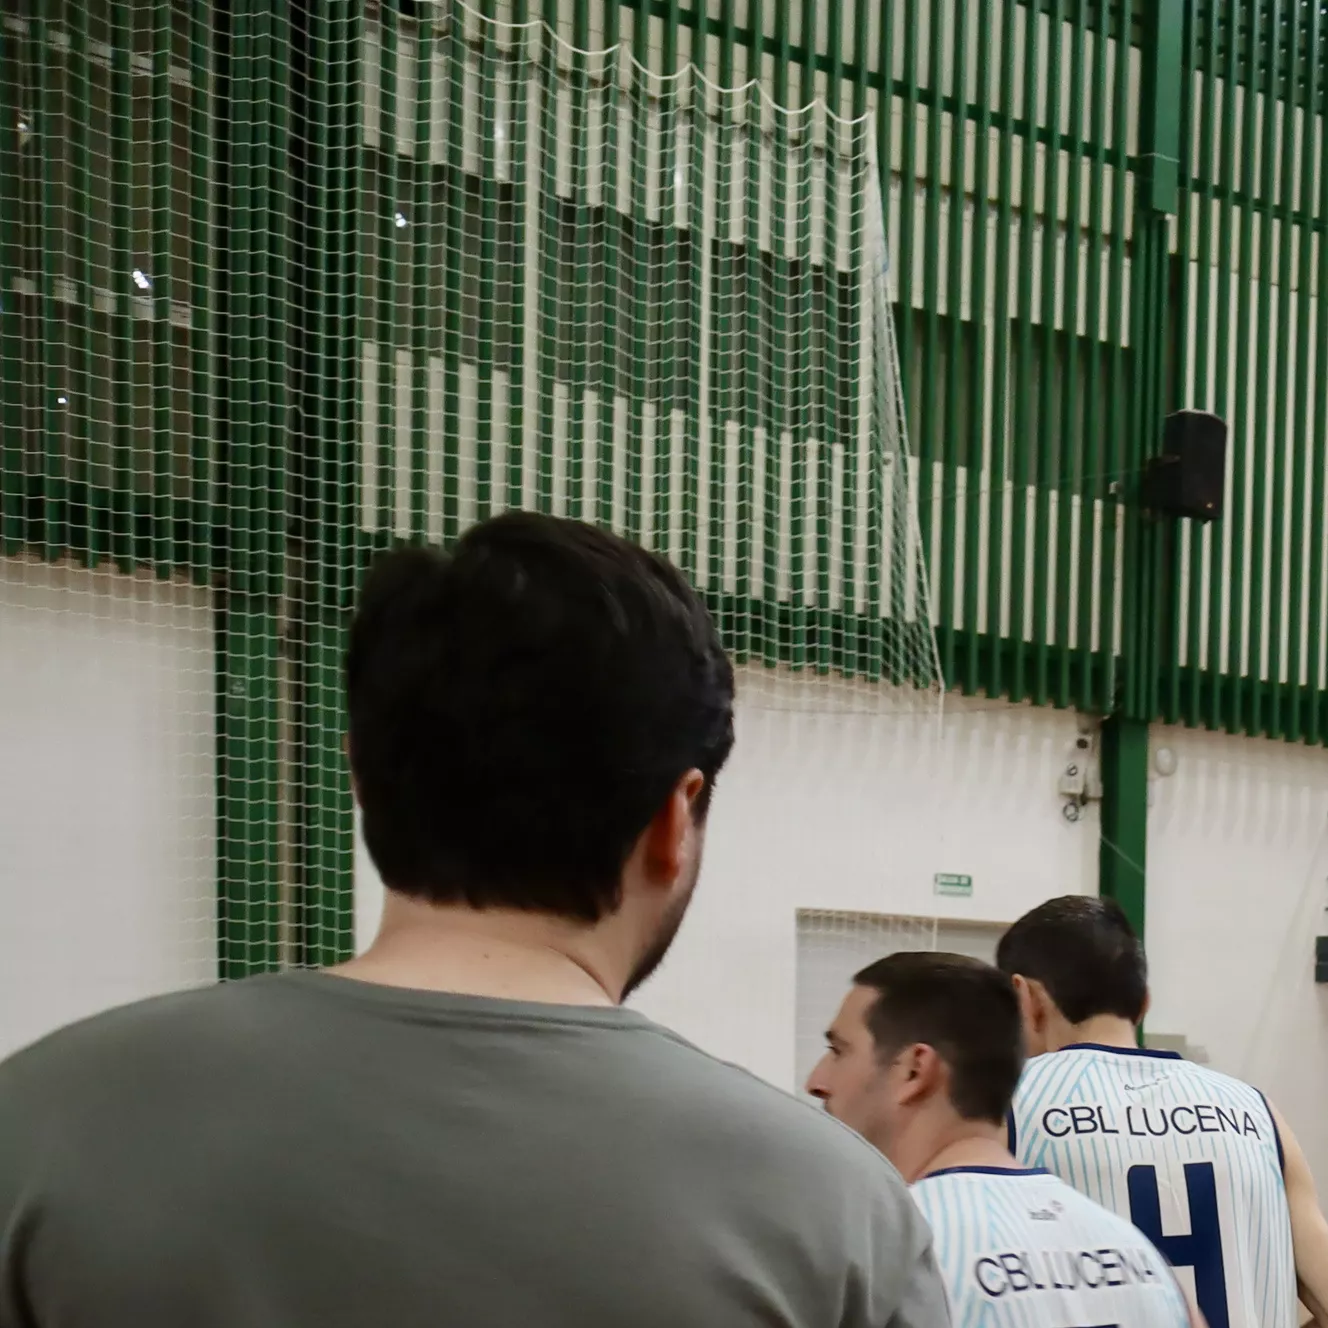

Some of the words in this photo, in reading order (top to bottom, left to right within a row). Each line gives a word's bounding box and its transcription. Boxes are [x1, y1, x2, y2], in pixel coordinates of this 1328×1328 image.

[1042, 1105, 1120, 1137] CBL
[1126, 1104, 1262, 1141] LUCENA
[974, 1251, 1045, 1298] CBL
